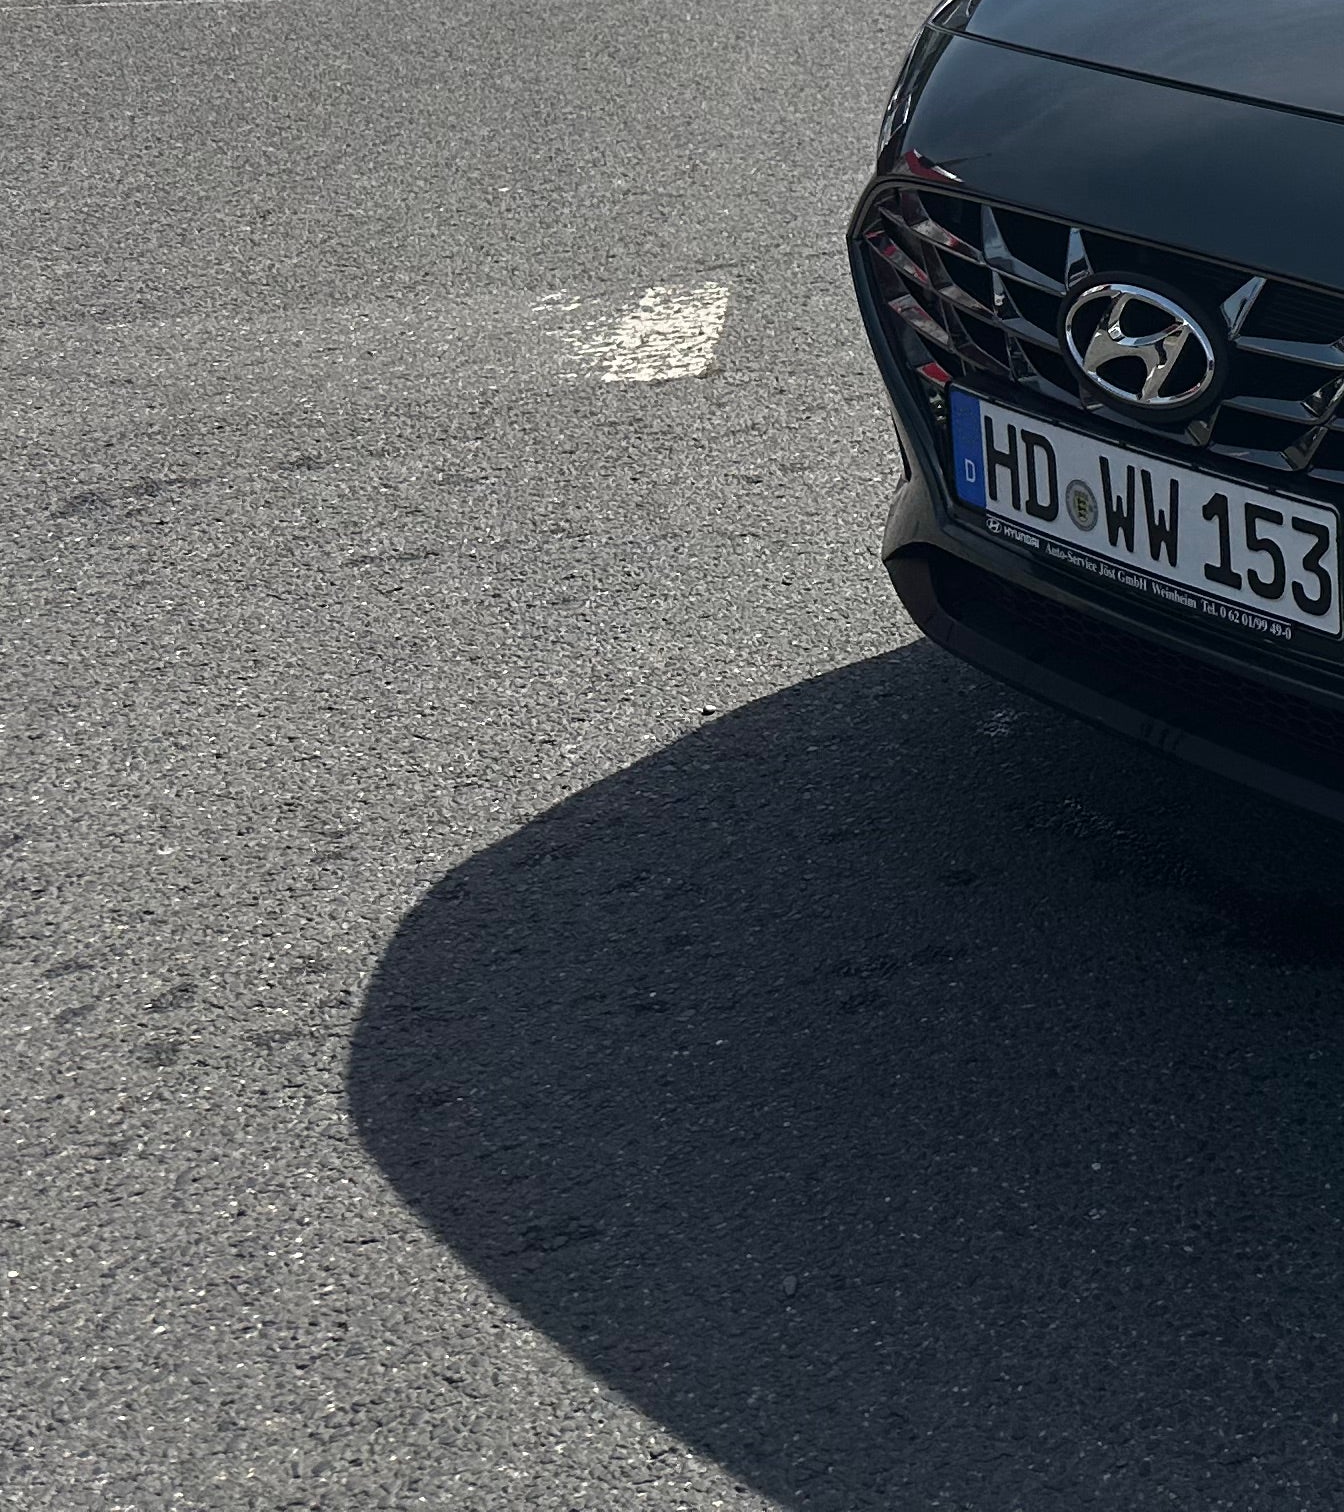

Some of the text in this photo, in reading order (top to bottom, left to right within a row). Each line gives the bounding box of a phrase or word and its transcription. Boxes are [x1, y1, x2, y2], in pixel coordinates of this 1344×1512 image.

[964, 457, 976, 483] D
[984, 415, 1332, 616] HD WW 153
[1003, 525, 1040, 549] HYUNDAI
[1045, 542, 1098, 573] Auto-Service
[1099, 562, 1116, 580] Jöst
[1117, 570, 1147, 592] GmbH
[1151, 581, 1197, 609] Weinheim
